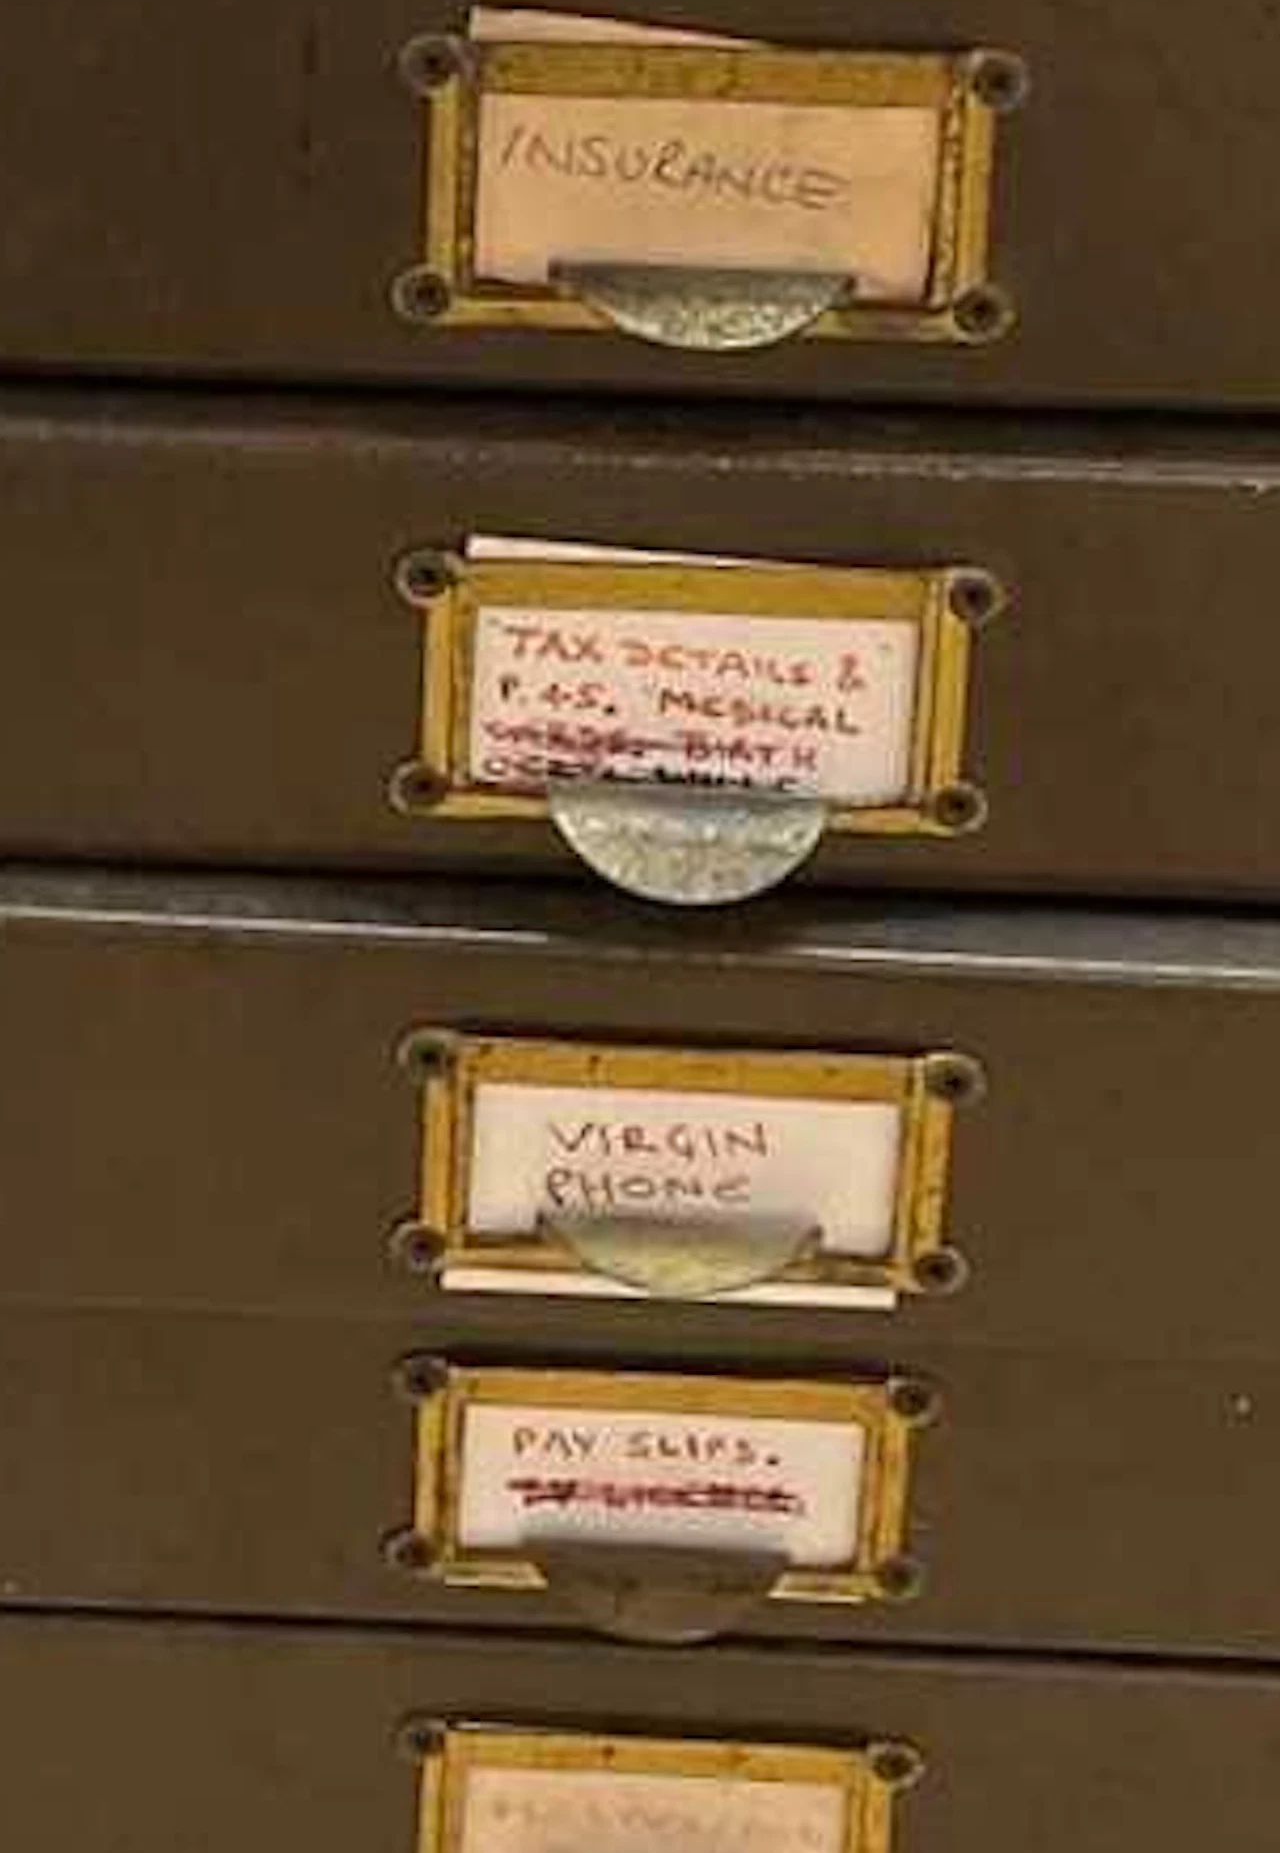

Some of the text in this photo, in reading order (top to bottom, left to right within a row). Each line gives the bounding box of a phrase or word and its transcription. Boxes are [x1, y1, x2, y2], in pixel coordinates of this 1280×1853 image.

[498, 124, 854, 210] INSURANCE
[505, 624, 866, 692] TAX DETAILS &
[551, 1120, 768, 1158] VIRGIN
[546, 1166, 751, 1205] PHONE
[514, 1427, 594, 1460] PAY
